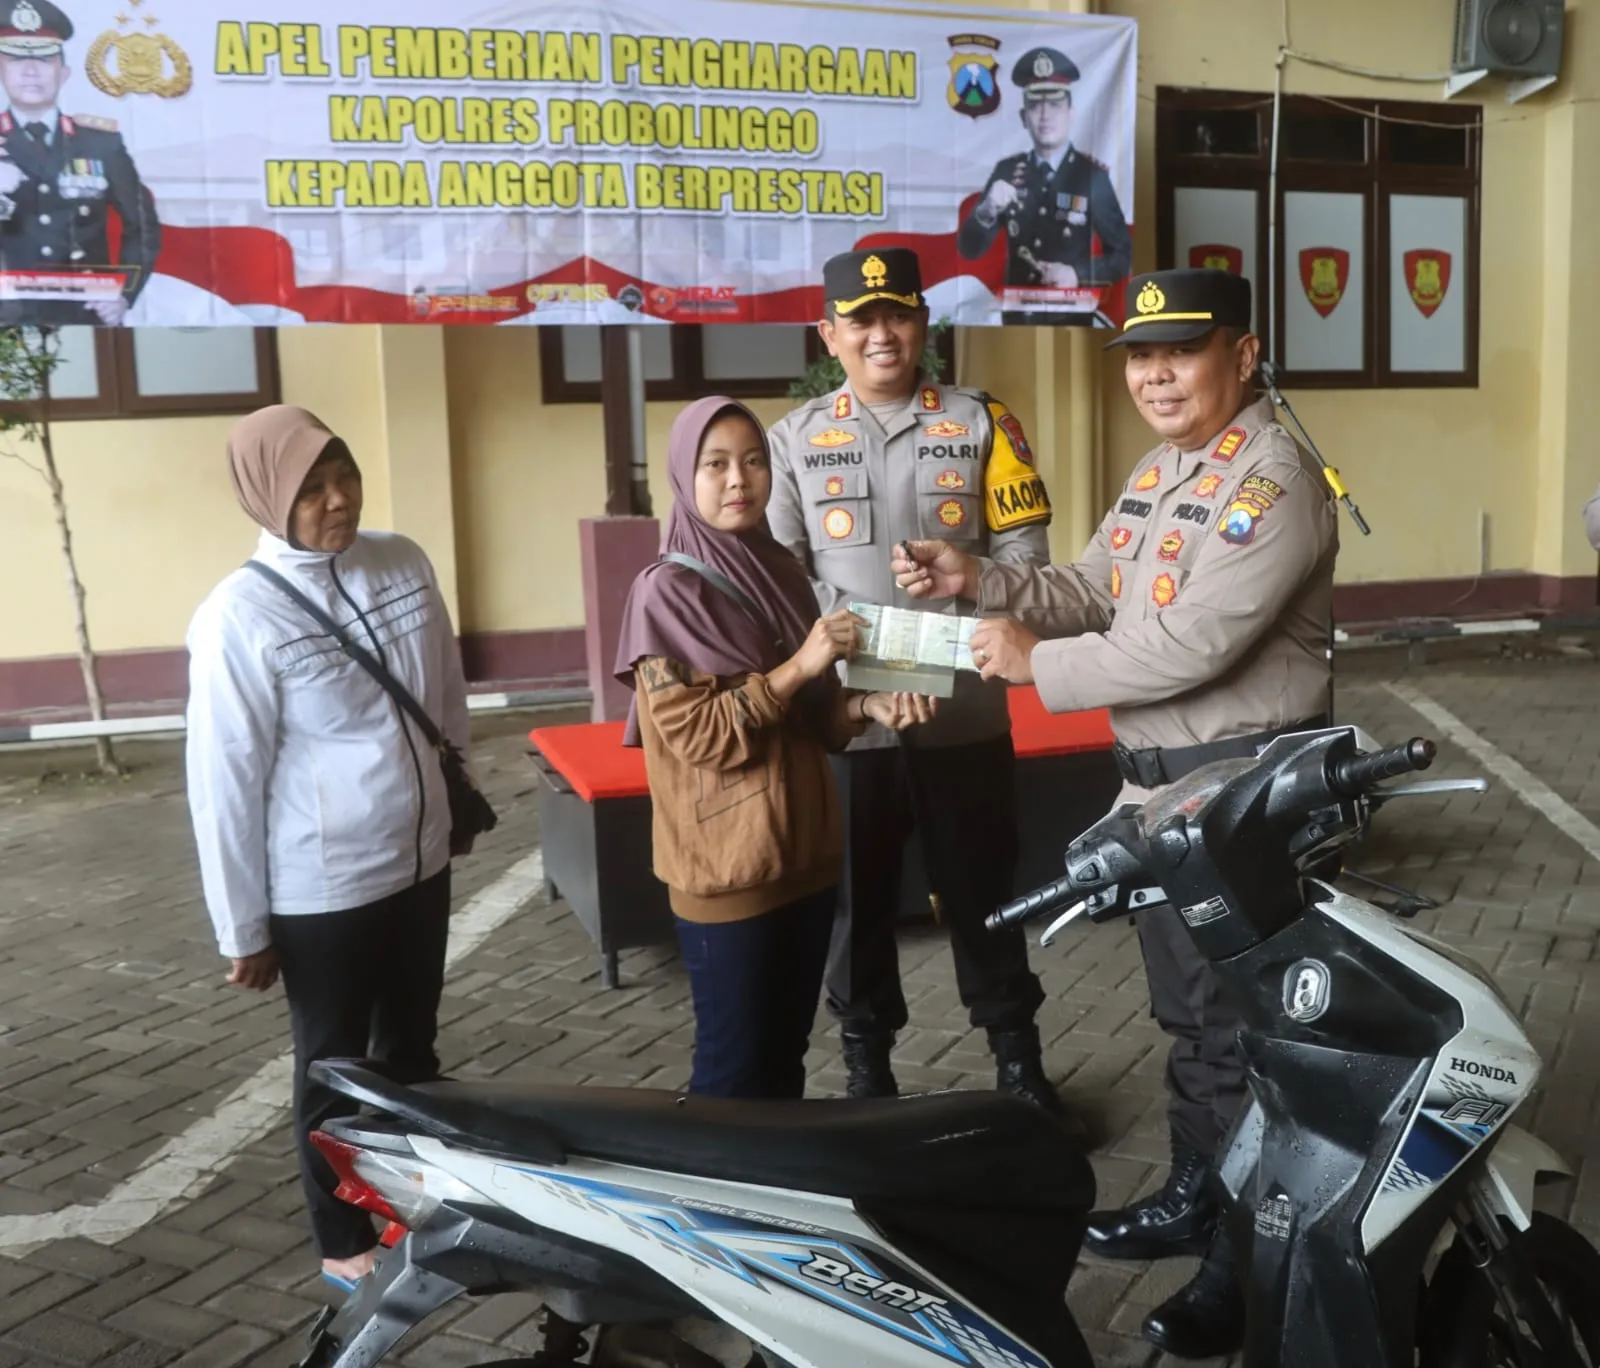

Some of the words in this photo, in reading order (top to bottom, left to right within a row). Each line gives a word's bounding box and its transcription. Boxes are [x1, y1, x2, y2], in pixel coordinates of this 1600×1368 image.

[215, 21, 329, 77] APEL
[338, 24, 602, 84] PEMBERIAN
[610, 33, 918, 99] PENGHARGAAN
[328, 95, 540, 145] KAPOLRES
[548, 98, 819, 155] PROBOLINGGO
[266, 159, 431, 208] KEPADA
[437, 160, 629, 210] ANGGOTA
[634, 163, 884, 217] BERPRESTASI
[803, 451, 864, 470] WISNU
[917, 443, 979, 461] POLRI
[1449, 1057, 1518, 1085] HONDA
[1440, 1096, 1508, 1127] FI
